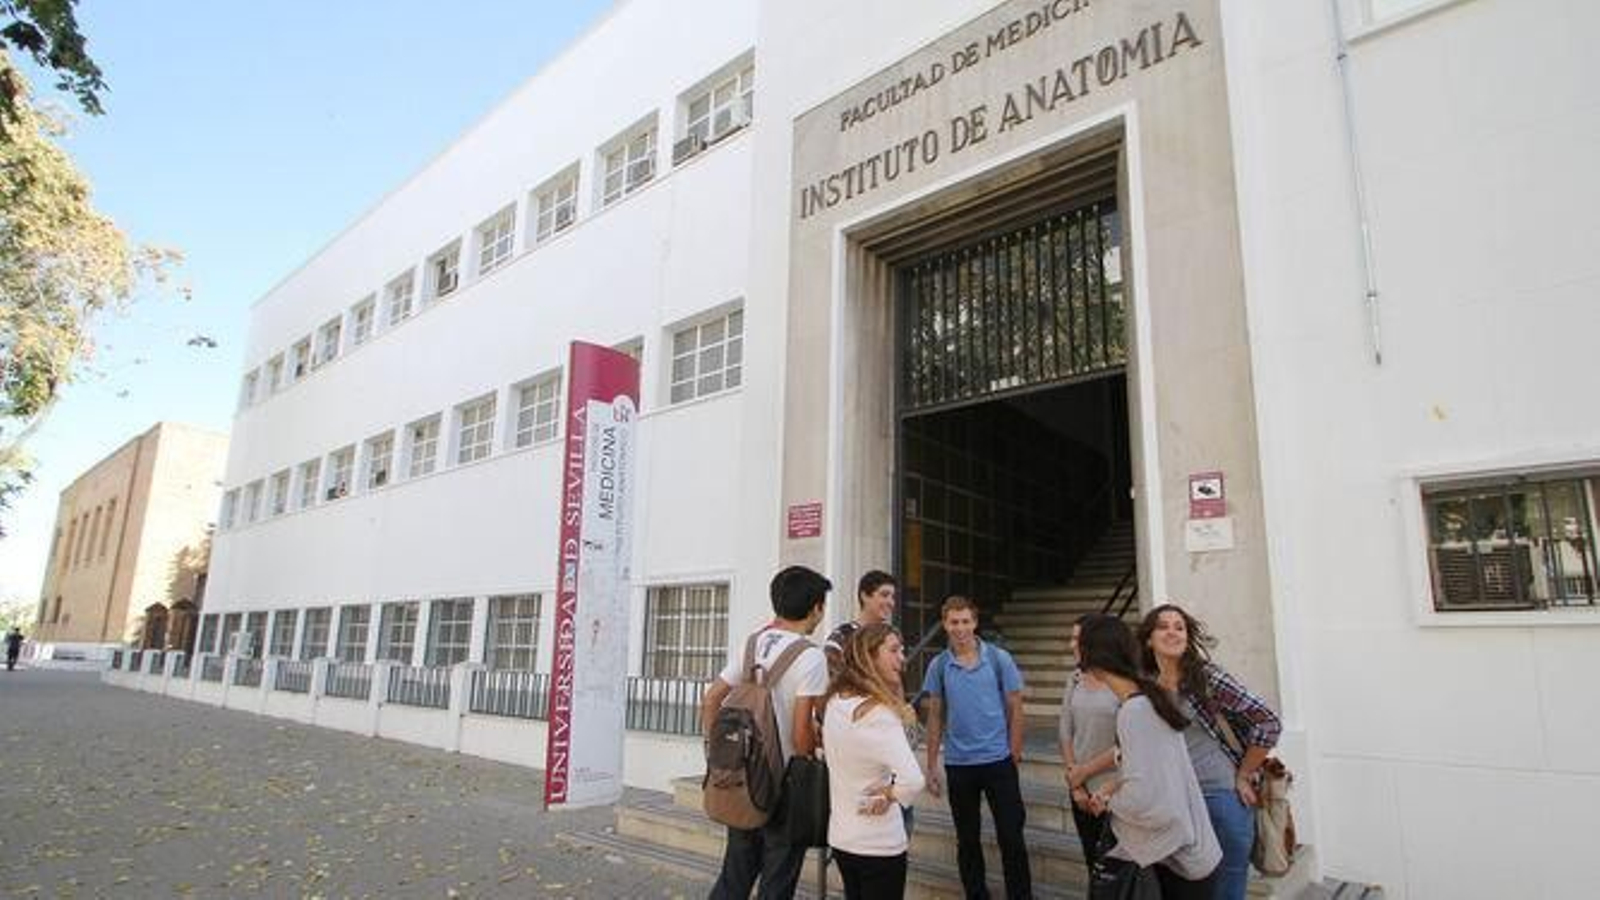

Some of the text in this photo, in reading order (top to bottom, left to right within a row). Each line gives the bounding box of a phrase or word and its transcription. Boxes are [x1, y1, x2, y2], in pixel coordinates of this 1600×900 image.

[800, 11, 1203, 219] INSTITUTO DE ANATOMIA
[840, 62, 945, 132] FACULTAD
[951, 42, 979, 75] DE
[565, 404, 586, 528] SEVILLA
[598, 426, 616, 521] MEDICINA
